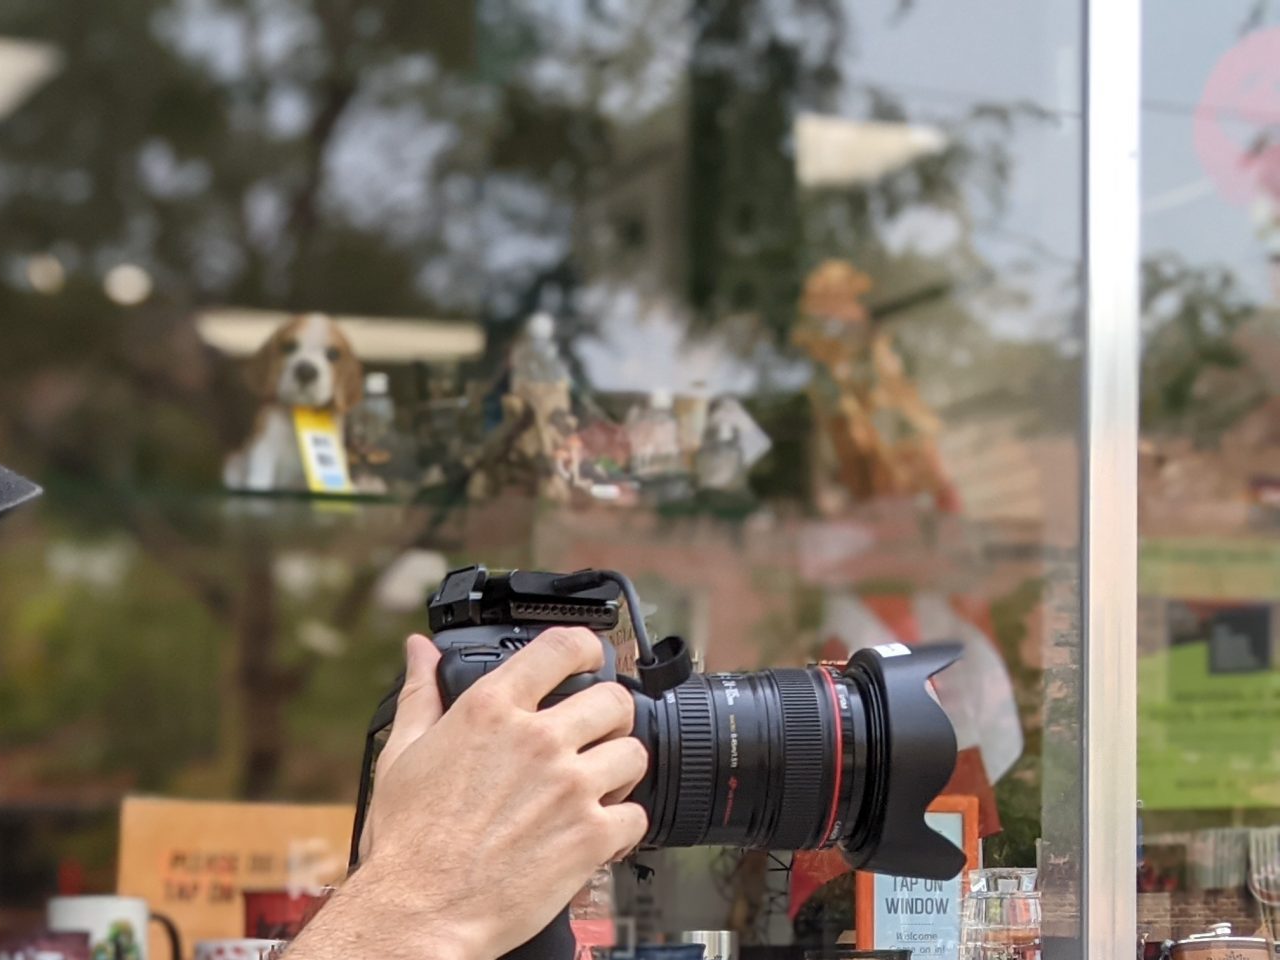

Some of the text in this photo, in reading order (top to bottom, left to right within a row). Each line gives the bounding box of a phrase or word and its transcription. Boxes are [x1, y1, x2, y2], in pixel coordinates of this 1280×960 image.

[893, 876, 943, 892] TAP ON
[885, 898, 949, 915] WINDOW
[896, 932, 938, 942] Welcome
